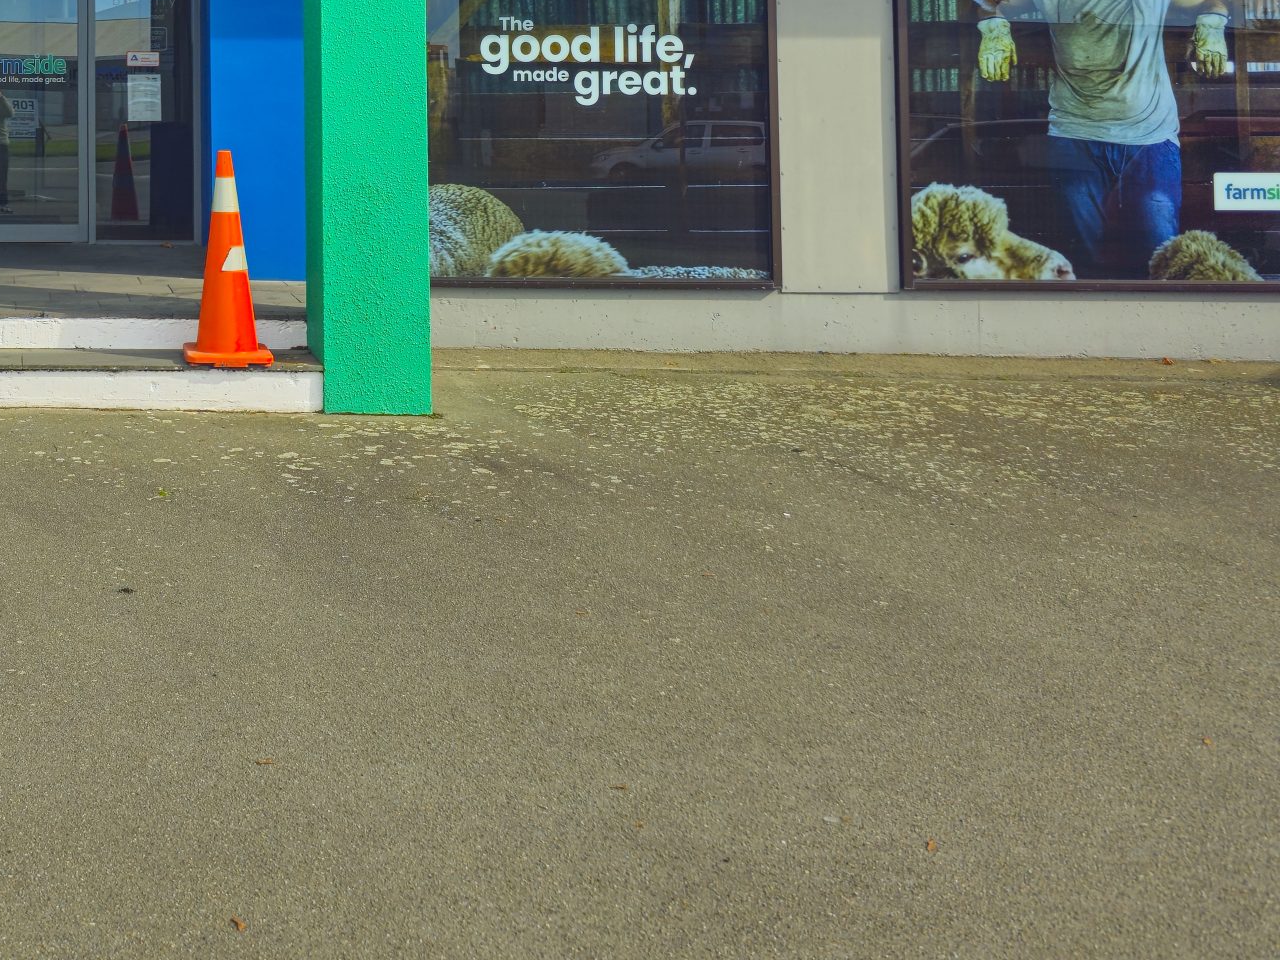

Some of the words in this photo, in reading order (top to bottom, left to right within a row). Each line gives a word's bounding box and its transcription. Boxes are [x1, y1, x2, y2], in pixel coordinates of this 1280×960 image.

[499, 16, 534, 31] The
[480, 26, 600, 75] good
[614, 23, 695, 69] life,
[8, 76, 21, 84] life,
[45, 76, 67, 85] great.
[513, 67, 569, 82] made
[574, 65, 698, 106] great.
